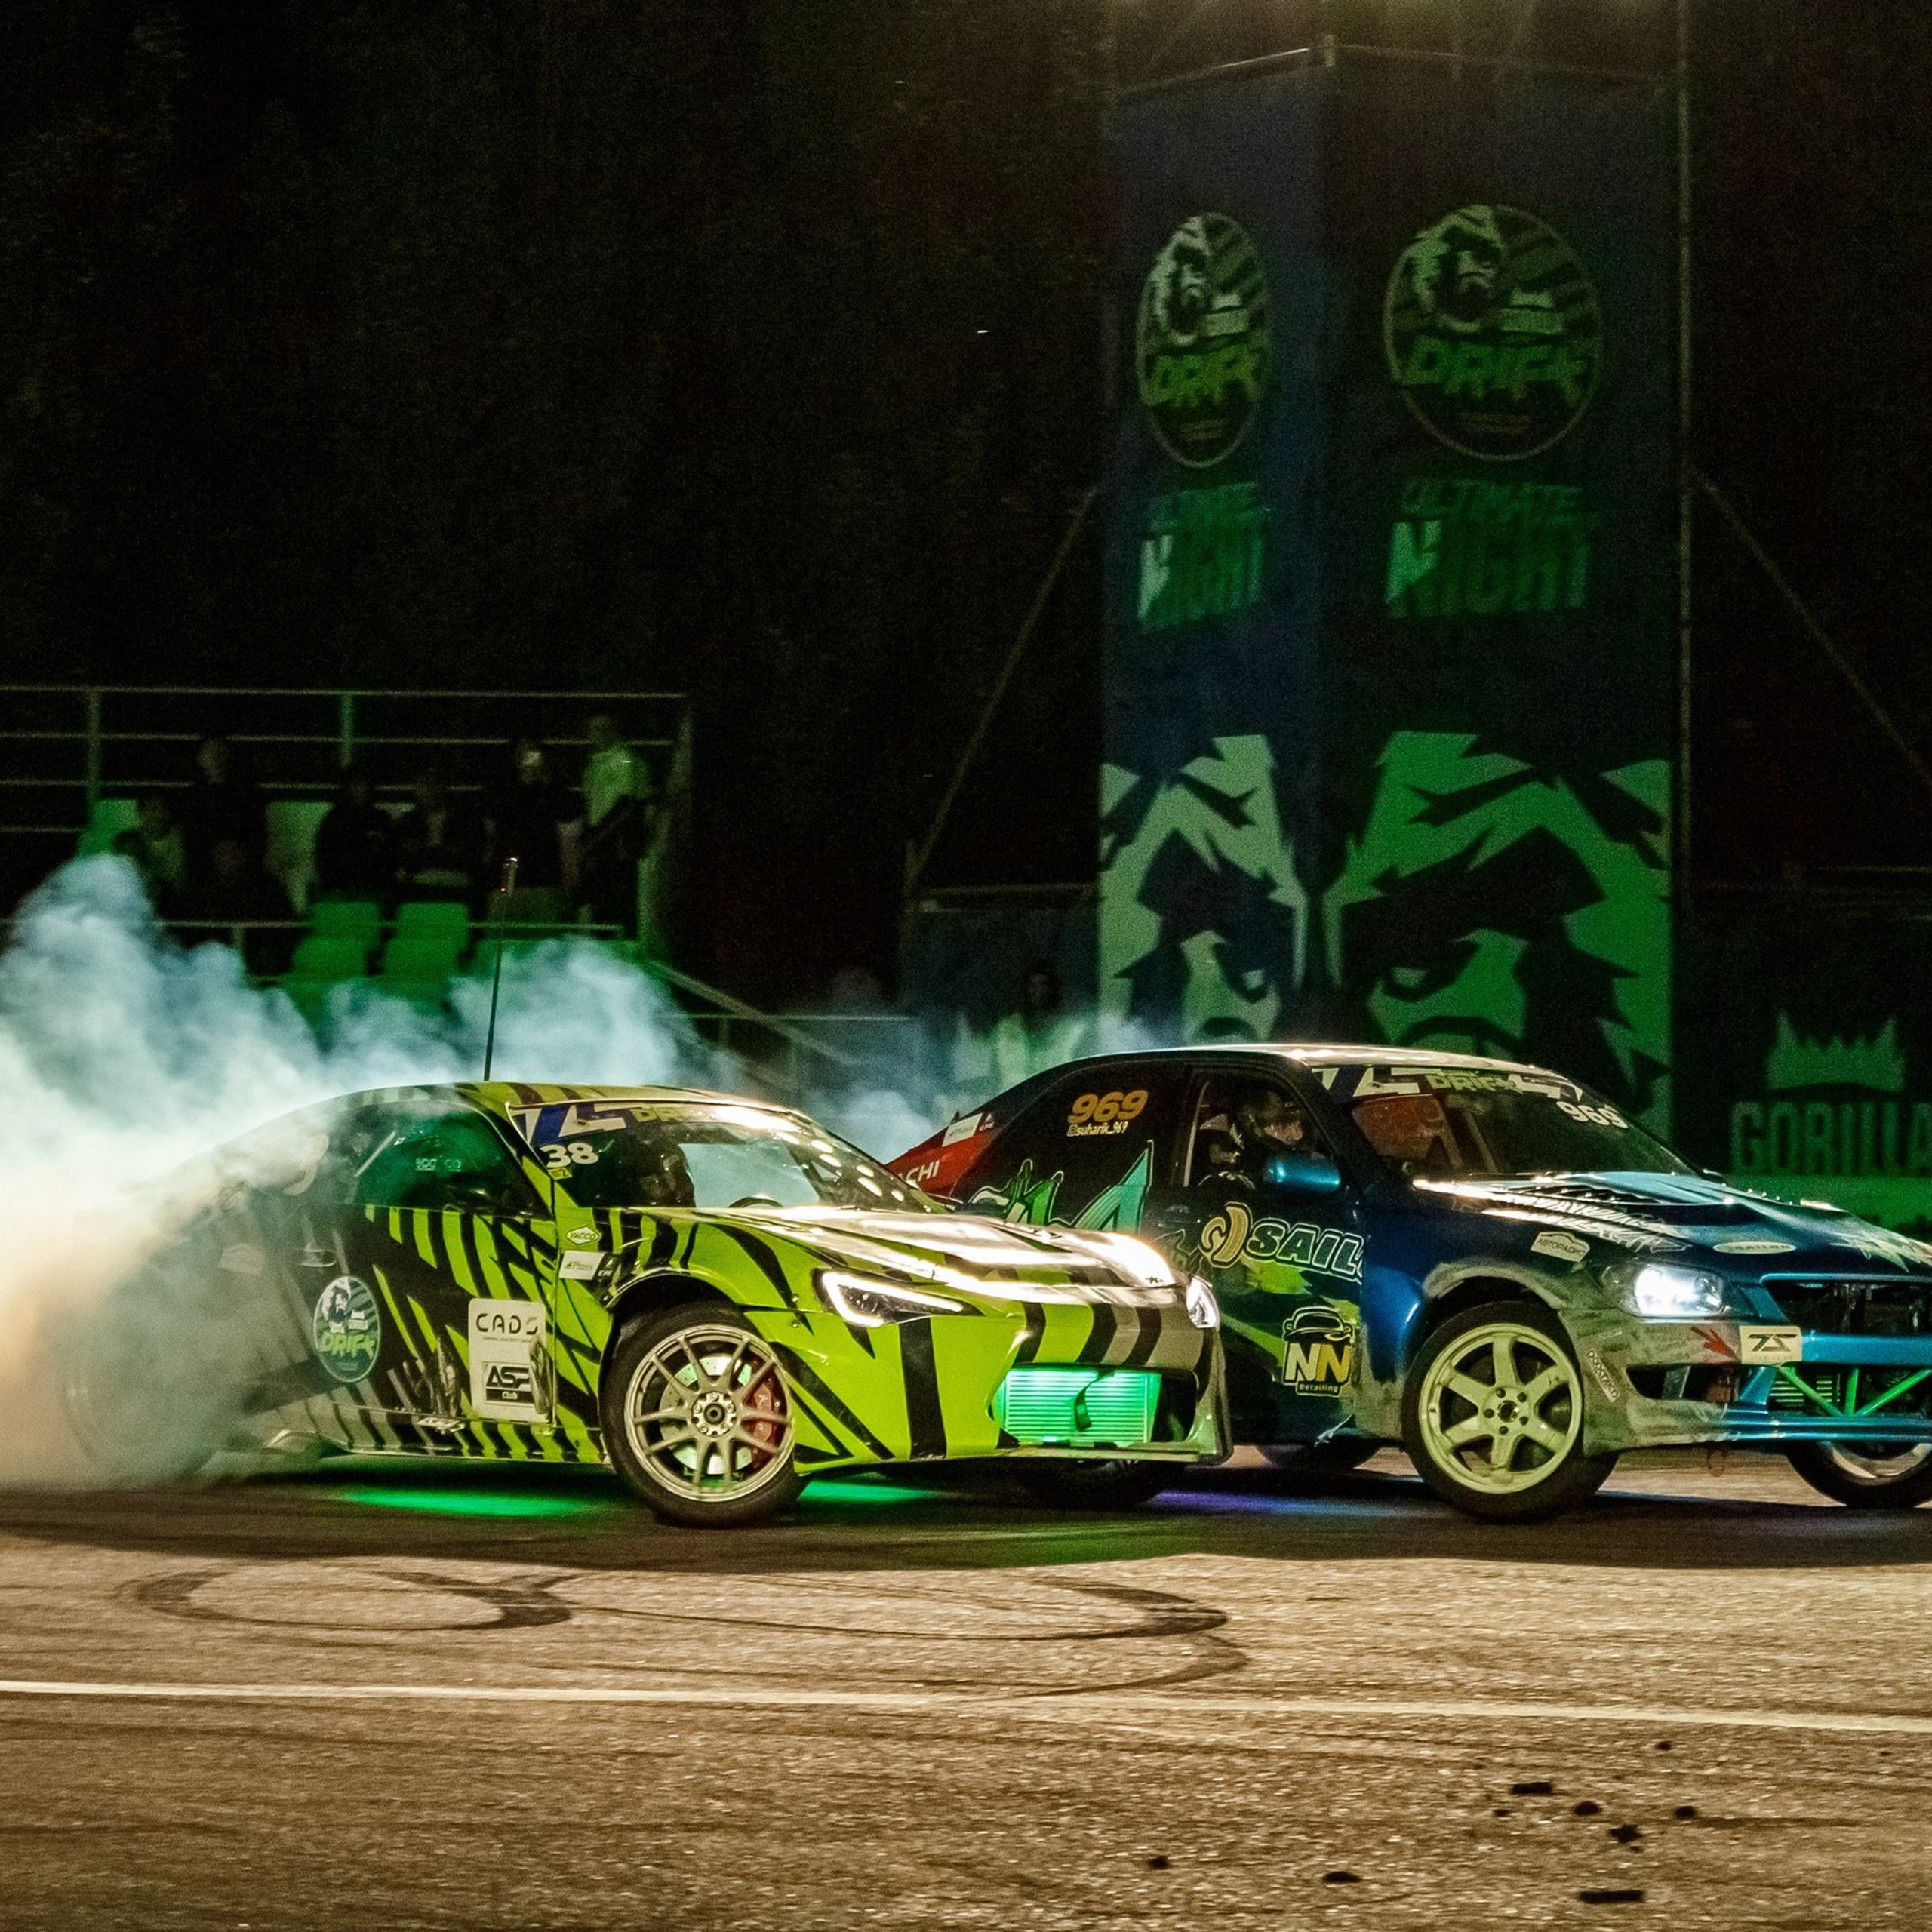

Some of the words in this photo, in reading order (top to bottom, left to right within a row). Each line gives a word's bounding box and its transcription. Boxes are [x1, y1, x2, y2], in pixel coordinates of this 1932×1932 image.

[1068, 1090, 1149, 1124] 969
[1556, 1100, 1629, 1129] 969
[540, 1143, 598, 1168] 38
[571, 1232, 596, 1241] YACCO
[318, 1331, 375, 1359] DRIFT
[1284, 1342, 1352, 1383] NN
[1299, 1384, 1338, 1393] Detailing
